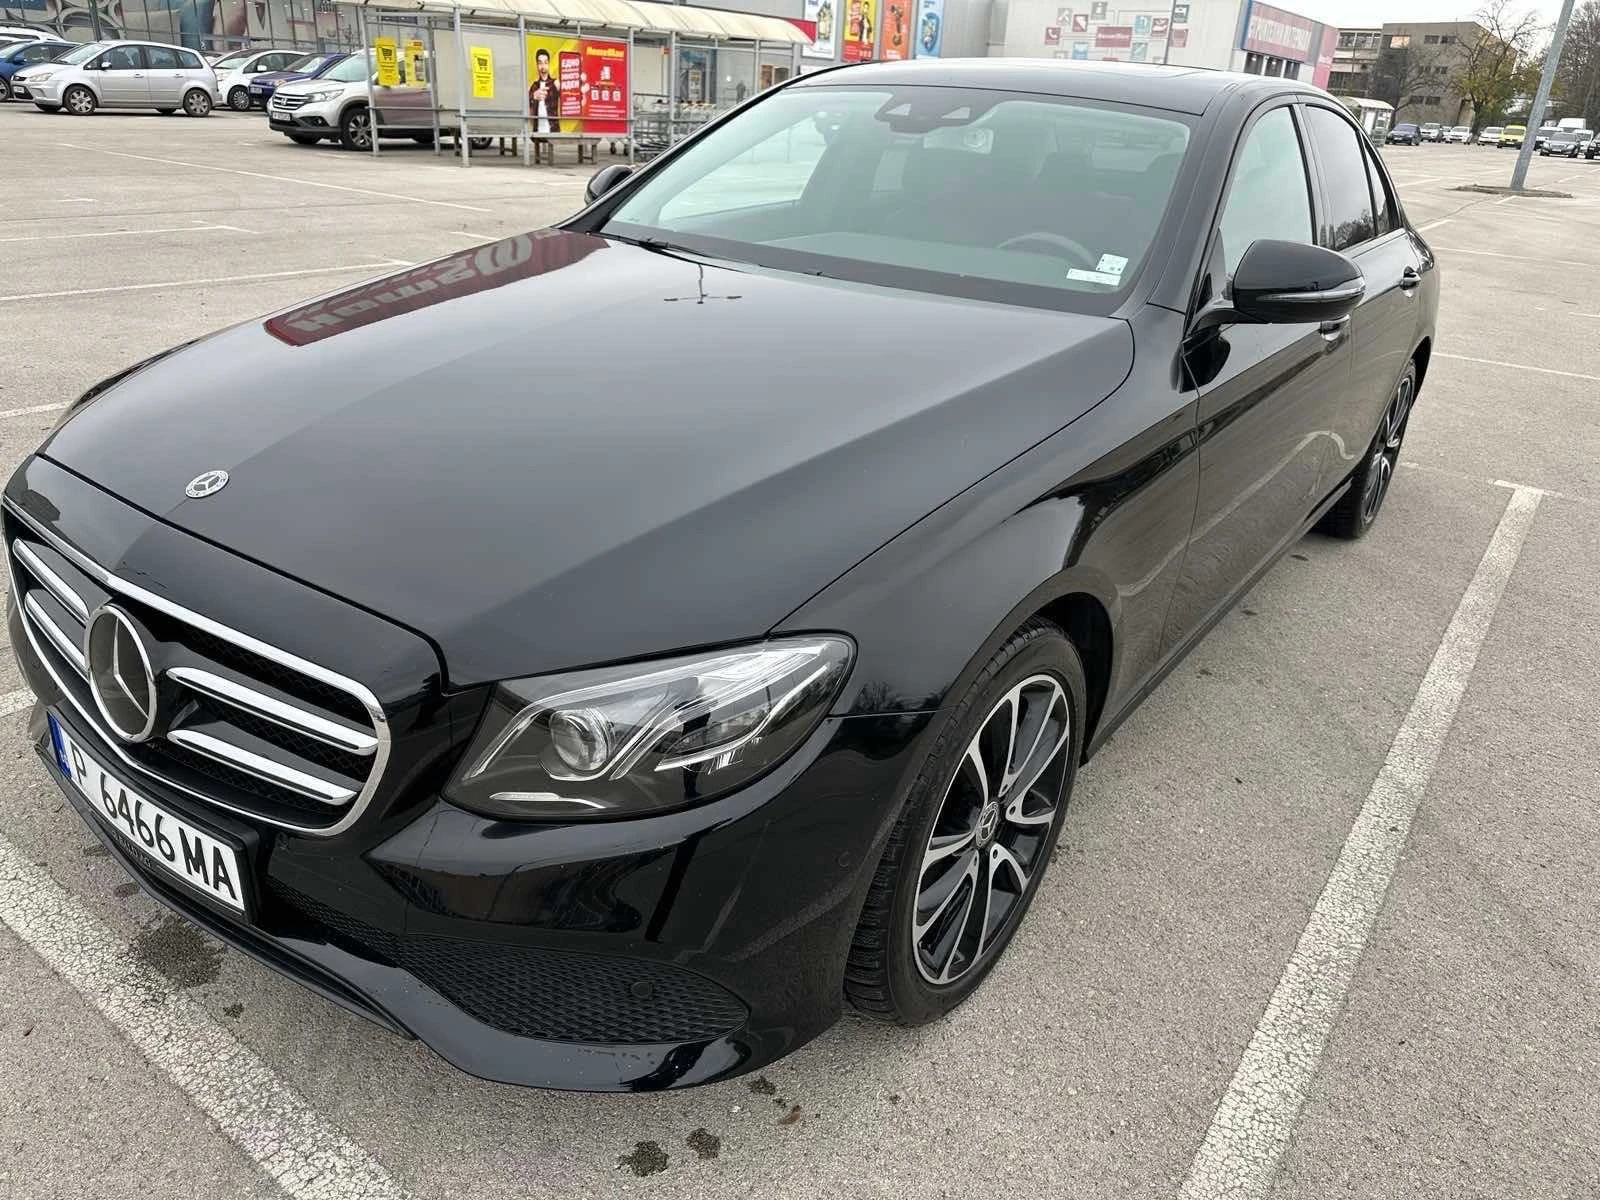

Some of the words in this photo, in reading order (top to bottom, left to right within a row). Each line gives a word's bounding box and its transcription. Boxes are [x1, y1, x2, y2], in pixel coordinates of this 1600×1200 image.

[70, 741, 87, 785] P
[100, 772, 175, 862] 6466
[178, 826, 239, 901] MA
